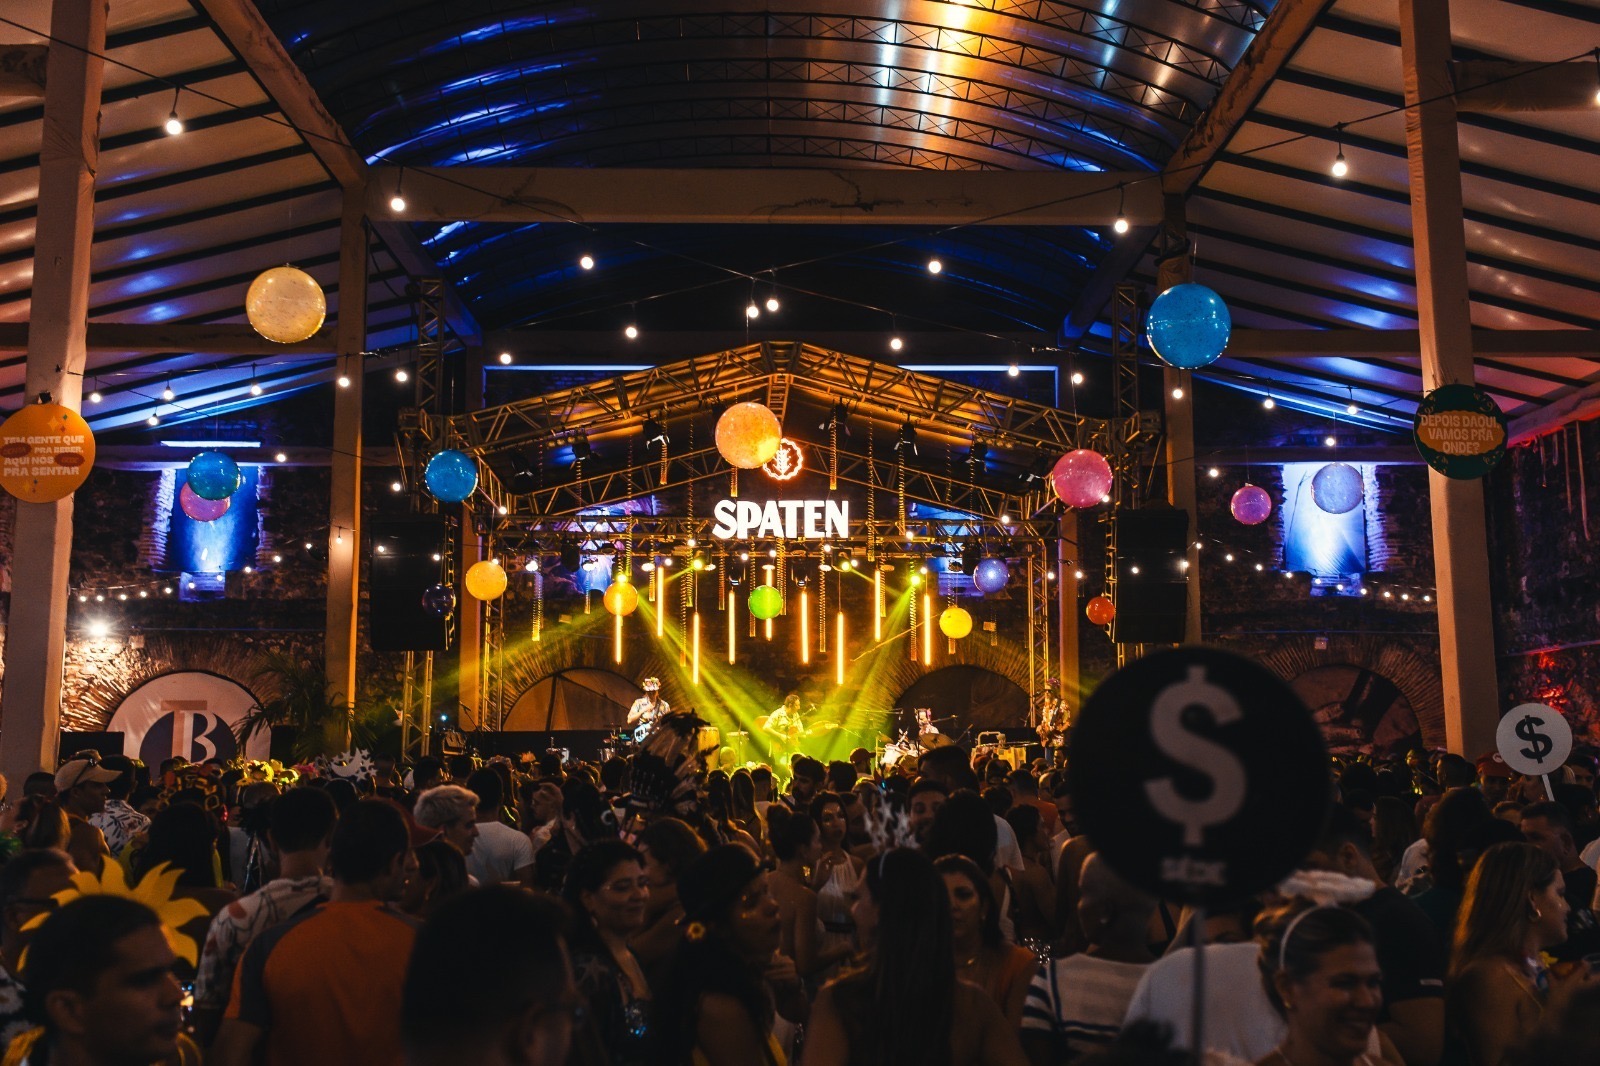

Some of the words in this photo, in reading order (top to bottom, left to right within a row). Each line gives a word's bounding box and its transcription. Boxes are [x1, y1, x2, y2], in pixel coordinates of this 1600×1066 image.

[1421, 415, 1460, 427] DEPOIS
[27, 436, 61, 444] GENTE
[63, 435, 84, 445] QUE
[1428, 428, 1469, 440] VAMOS
[1442, 441, 1480, 454] ONDE?
[4, 457, 29, 466] AQUI
[4, 468, 29, 476] PRA
[31, 466, 79, 476] SENTAR
[712, 500, 849, 539] SPATEN
